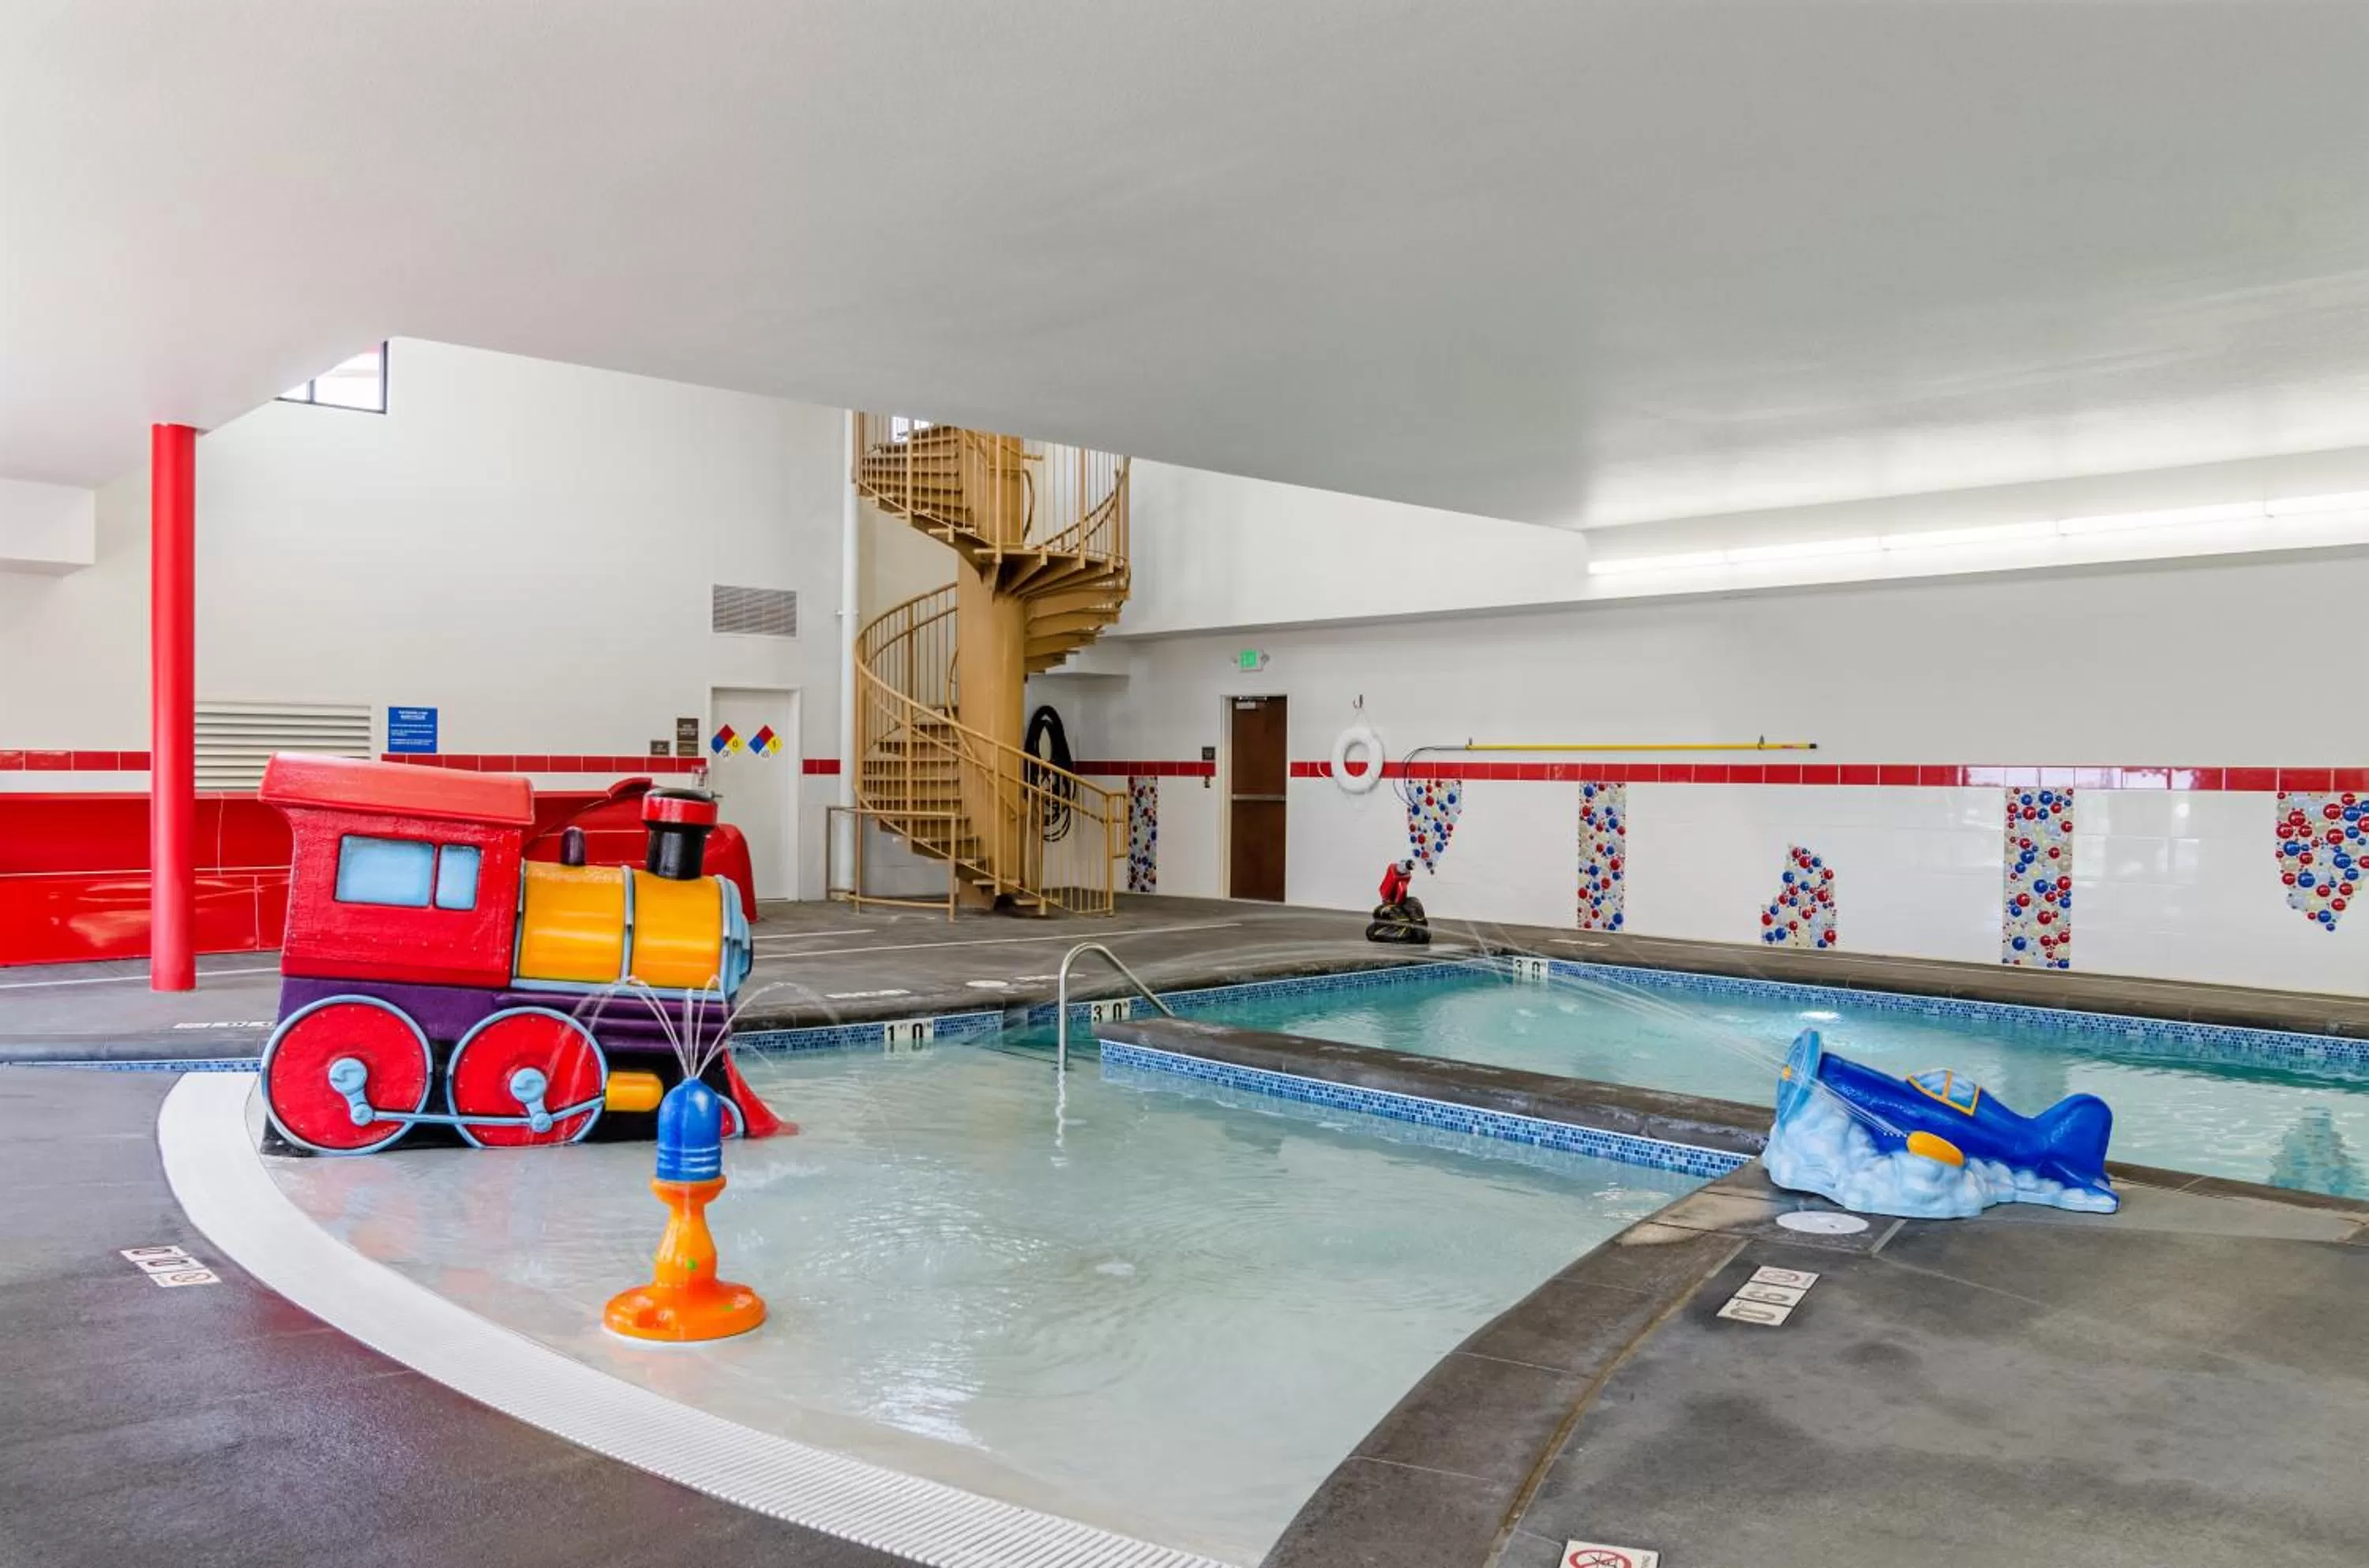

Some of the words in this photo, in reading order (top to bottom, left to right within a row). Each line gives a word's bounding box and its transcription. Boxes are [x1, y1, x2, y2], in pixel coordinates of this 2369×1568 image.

[1093, 1005, 1102, 1023] 3
[888, 1024, 895, 1042] 1
[912, 1022, 924, 1041] 0
